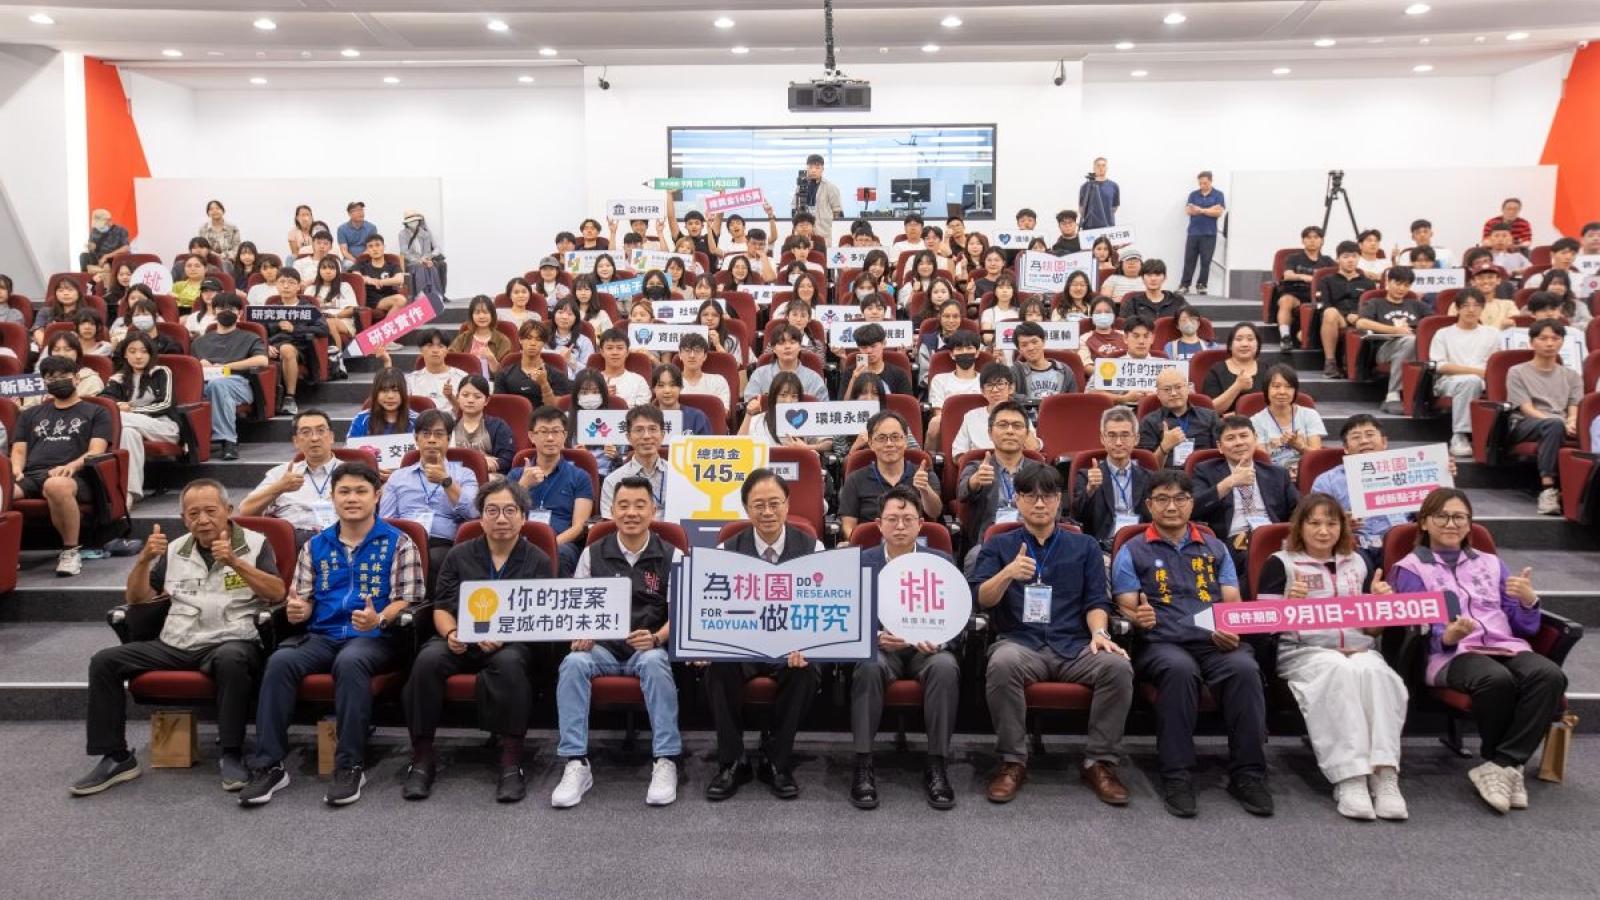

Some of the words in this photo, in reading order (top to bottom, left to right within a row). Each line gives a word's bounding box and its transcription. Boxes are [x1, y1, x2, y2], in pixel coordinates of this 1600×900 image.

[366, 306, 425, 346] 研究實作
[697, 448, 741, 460] 總獎金
[703, 572, 793, 601] 為桃園
[796, 577, 812, 587] DO
[507, 585, 608, 612] 你的提案
[796, 589, 852, 599] RESEARCH
[701, 608, 722, 618] FOR
[497, 612, 620, 634] 是城市的未來!
[701, 619, 758, 630] TAOYUAN
